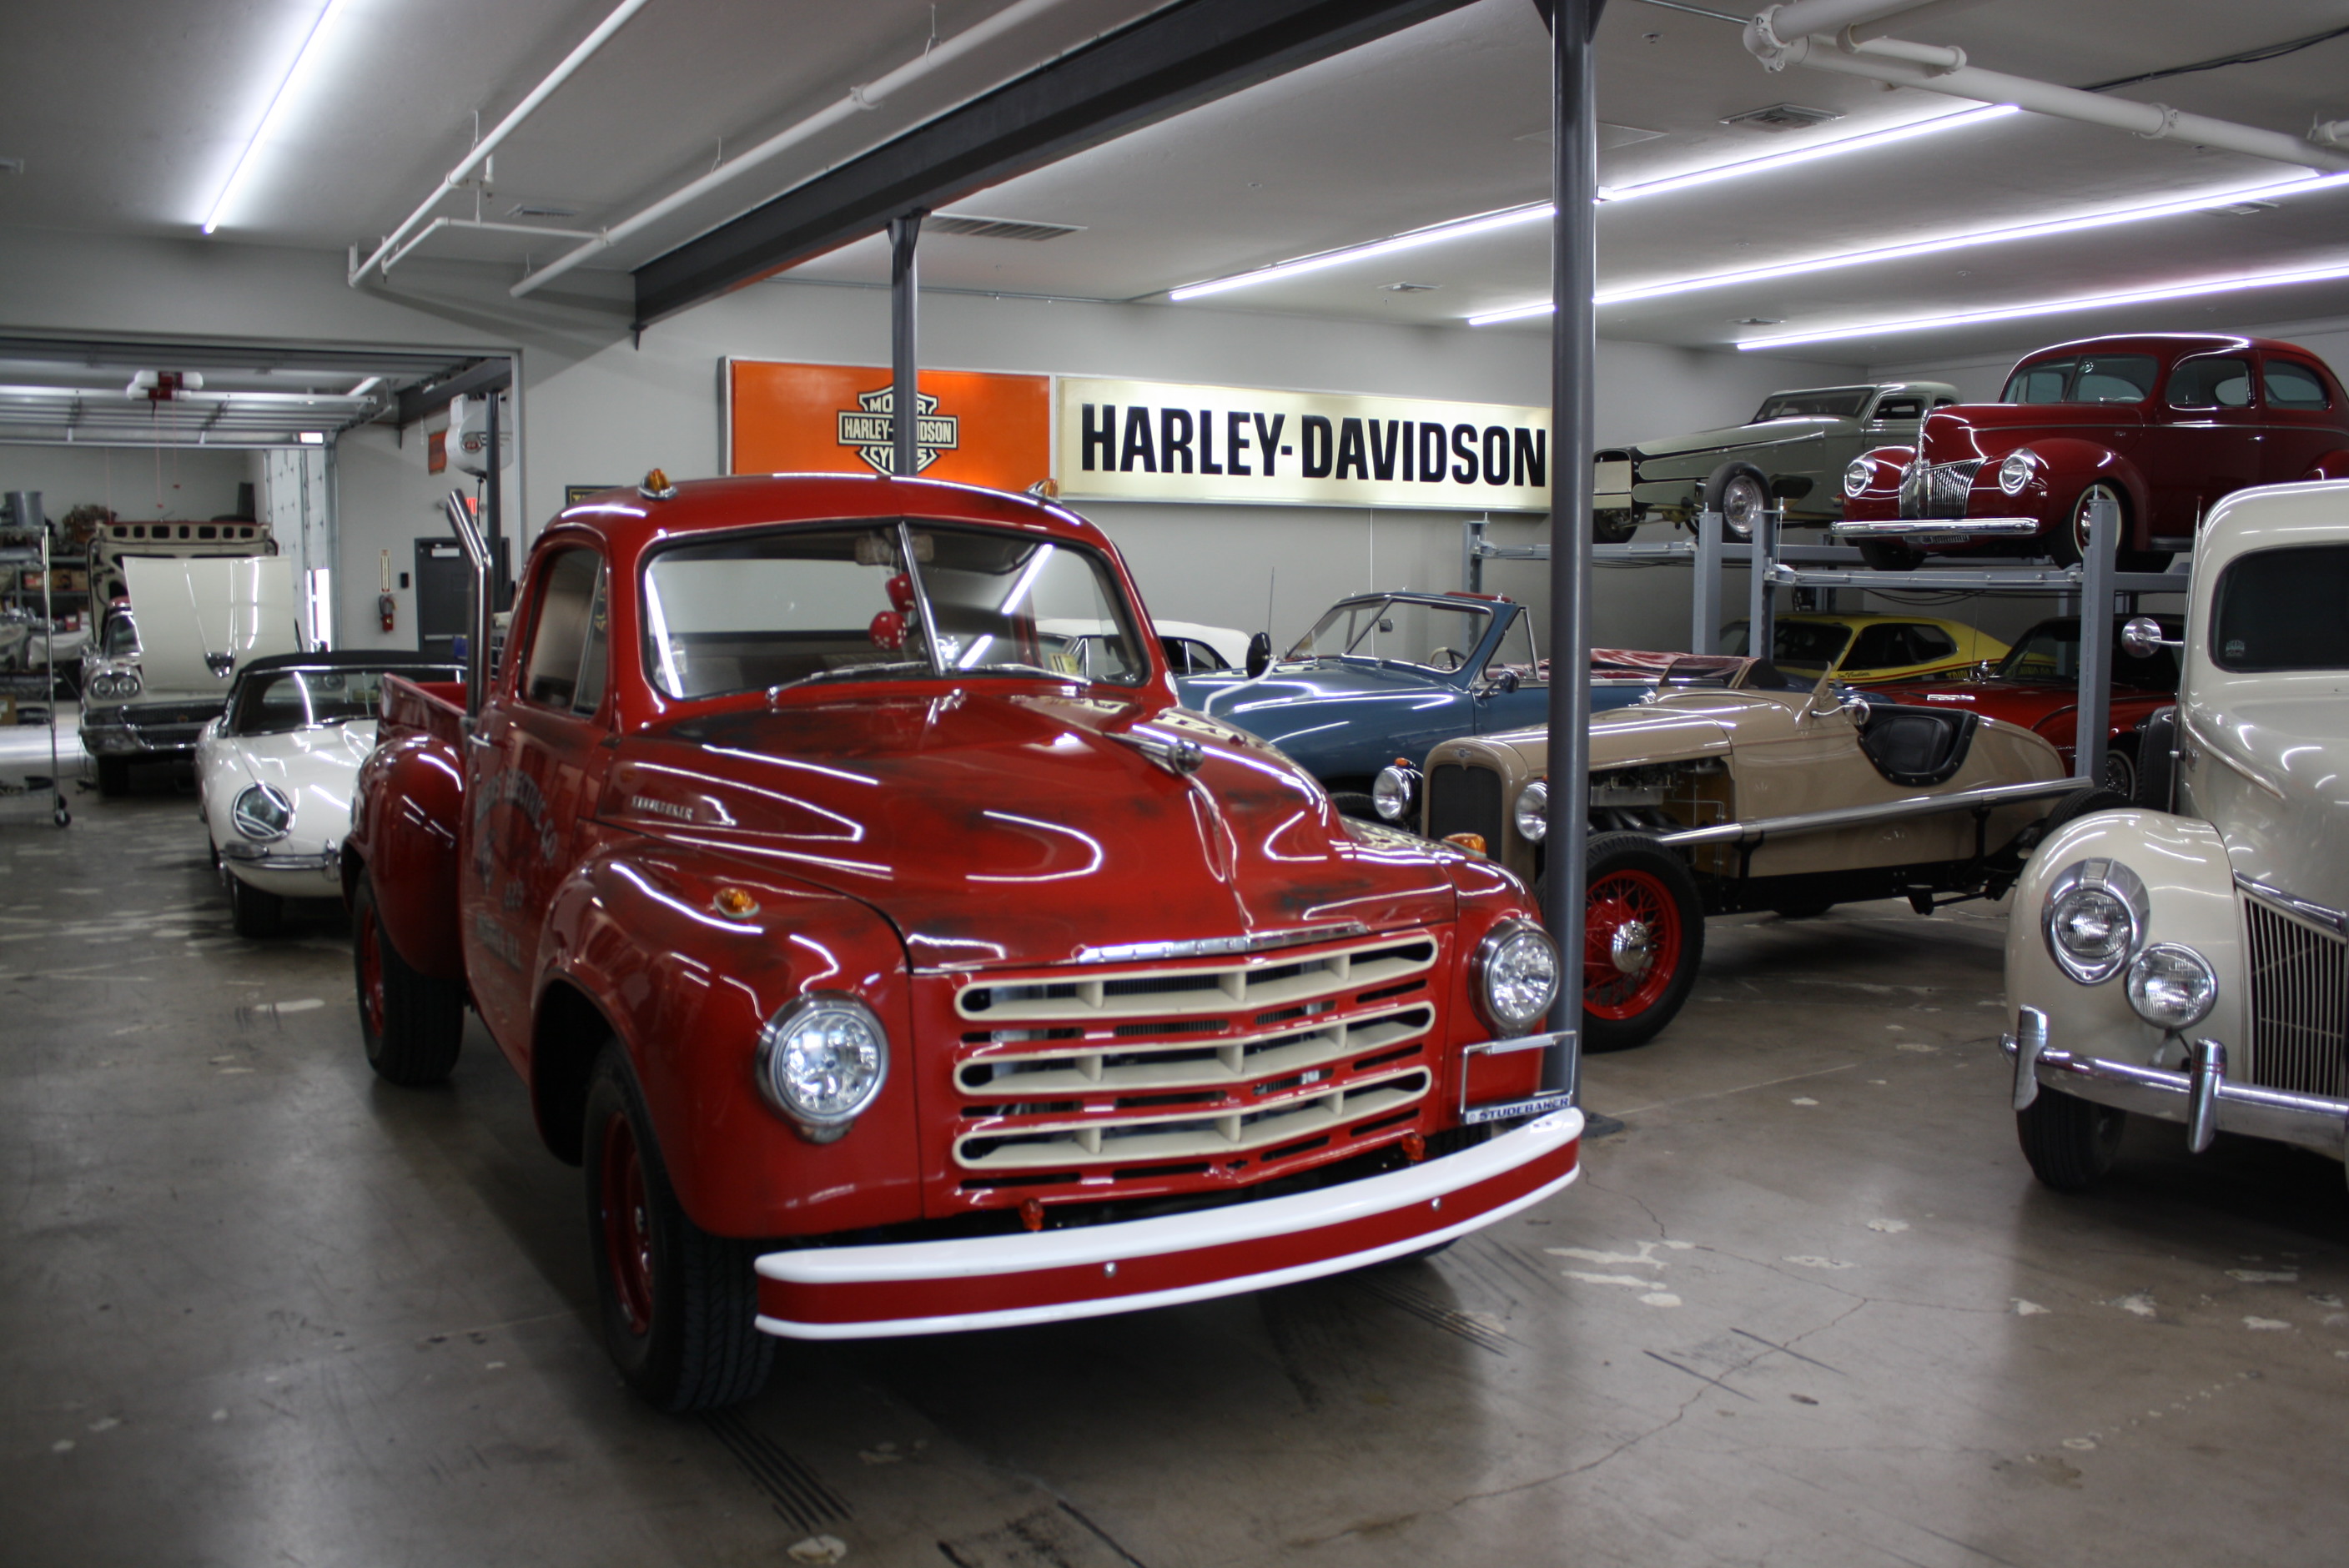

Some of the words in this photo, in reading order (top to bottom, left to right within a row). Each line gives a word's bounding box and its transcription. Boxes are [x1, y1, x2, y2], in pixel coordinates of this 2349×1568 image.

[869, 393, 927, 415] MOR
[844, 417, 952, 443] HARLEY-IDSON
[1081, 403, 1547, 488] HARLEY-DAVIDSON
[1479, 1098, 1569, 1121] STUDEBAKER
